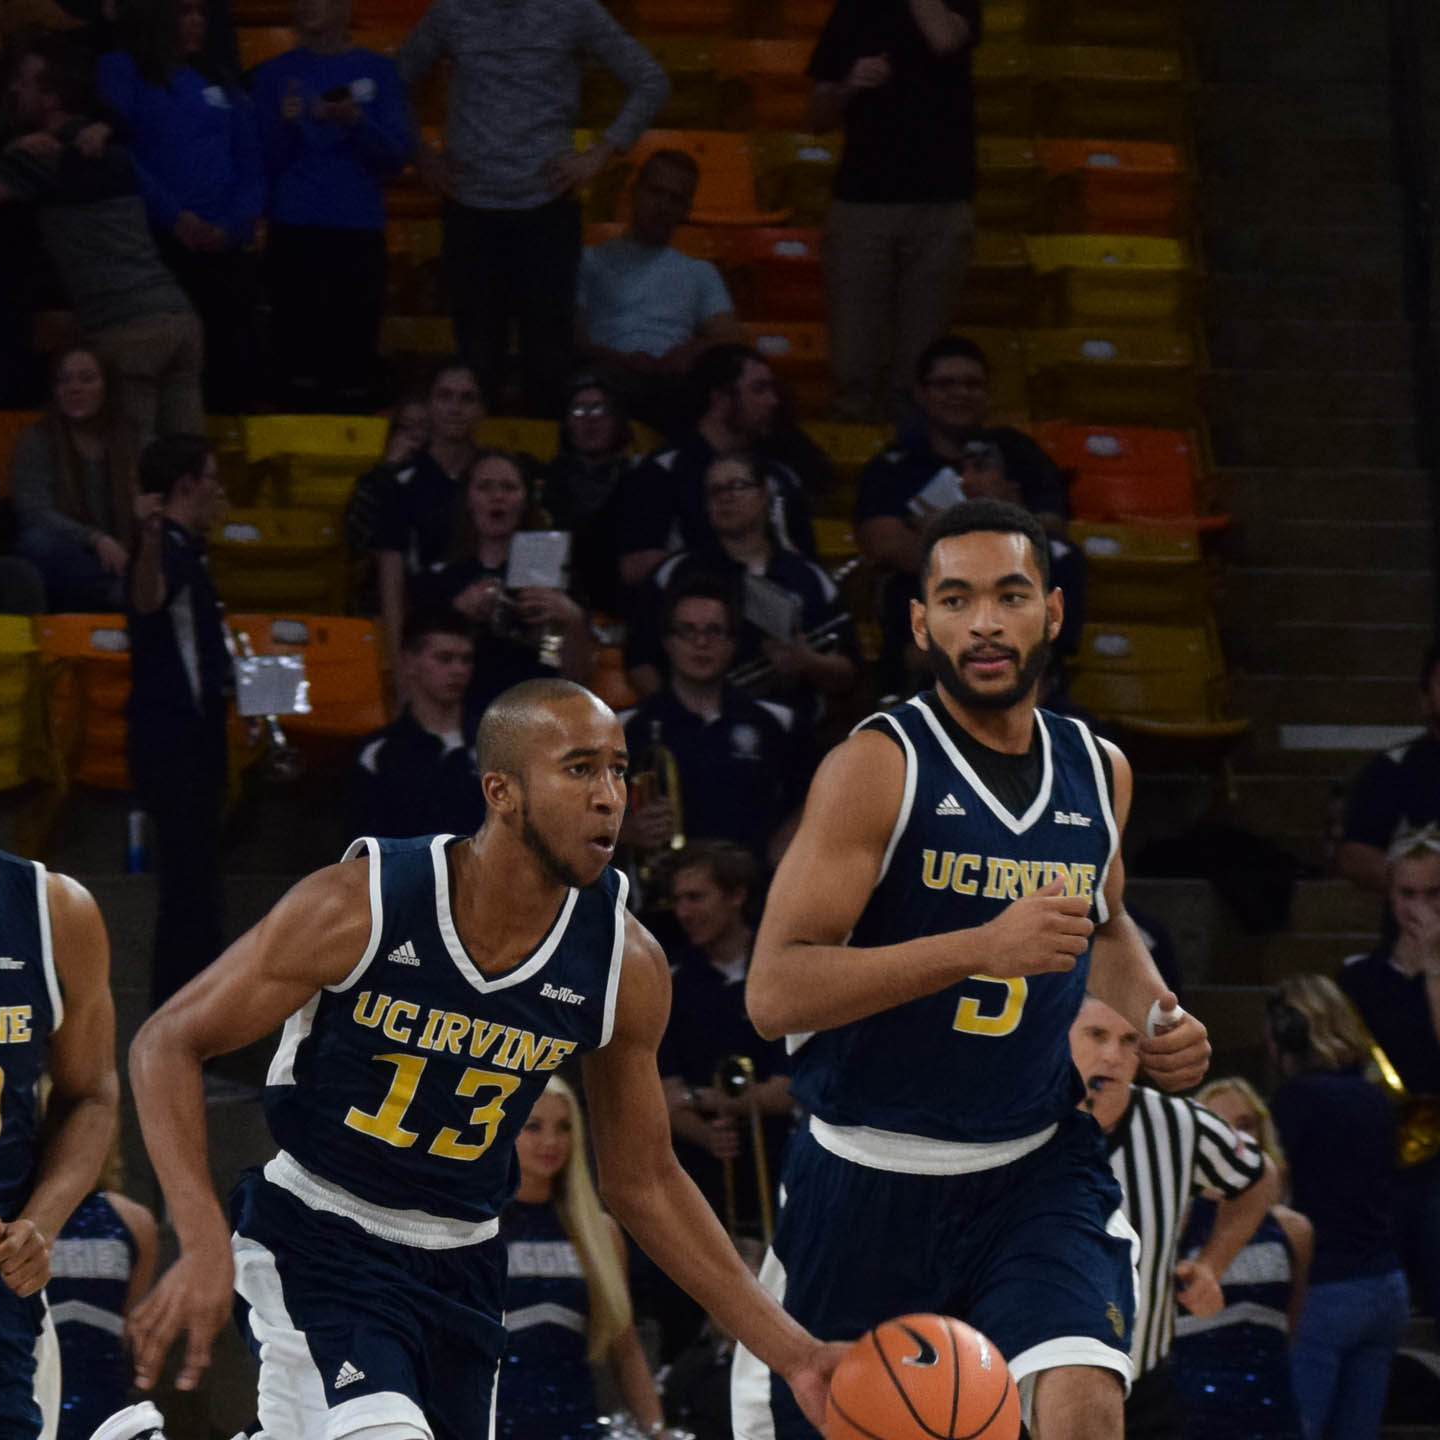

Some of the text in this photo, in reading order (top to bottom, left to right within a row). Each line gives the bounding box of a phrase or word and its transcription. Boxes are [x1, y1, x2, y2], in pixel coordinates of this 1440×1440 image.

[921, 849, 983, 897] UC
[387, 953, 421, 967] adidas
[352, 990, 579, 1072] UC IRVINE
[344, 1052, 522, 1162] 13
